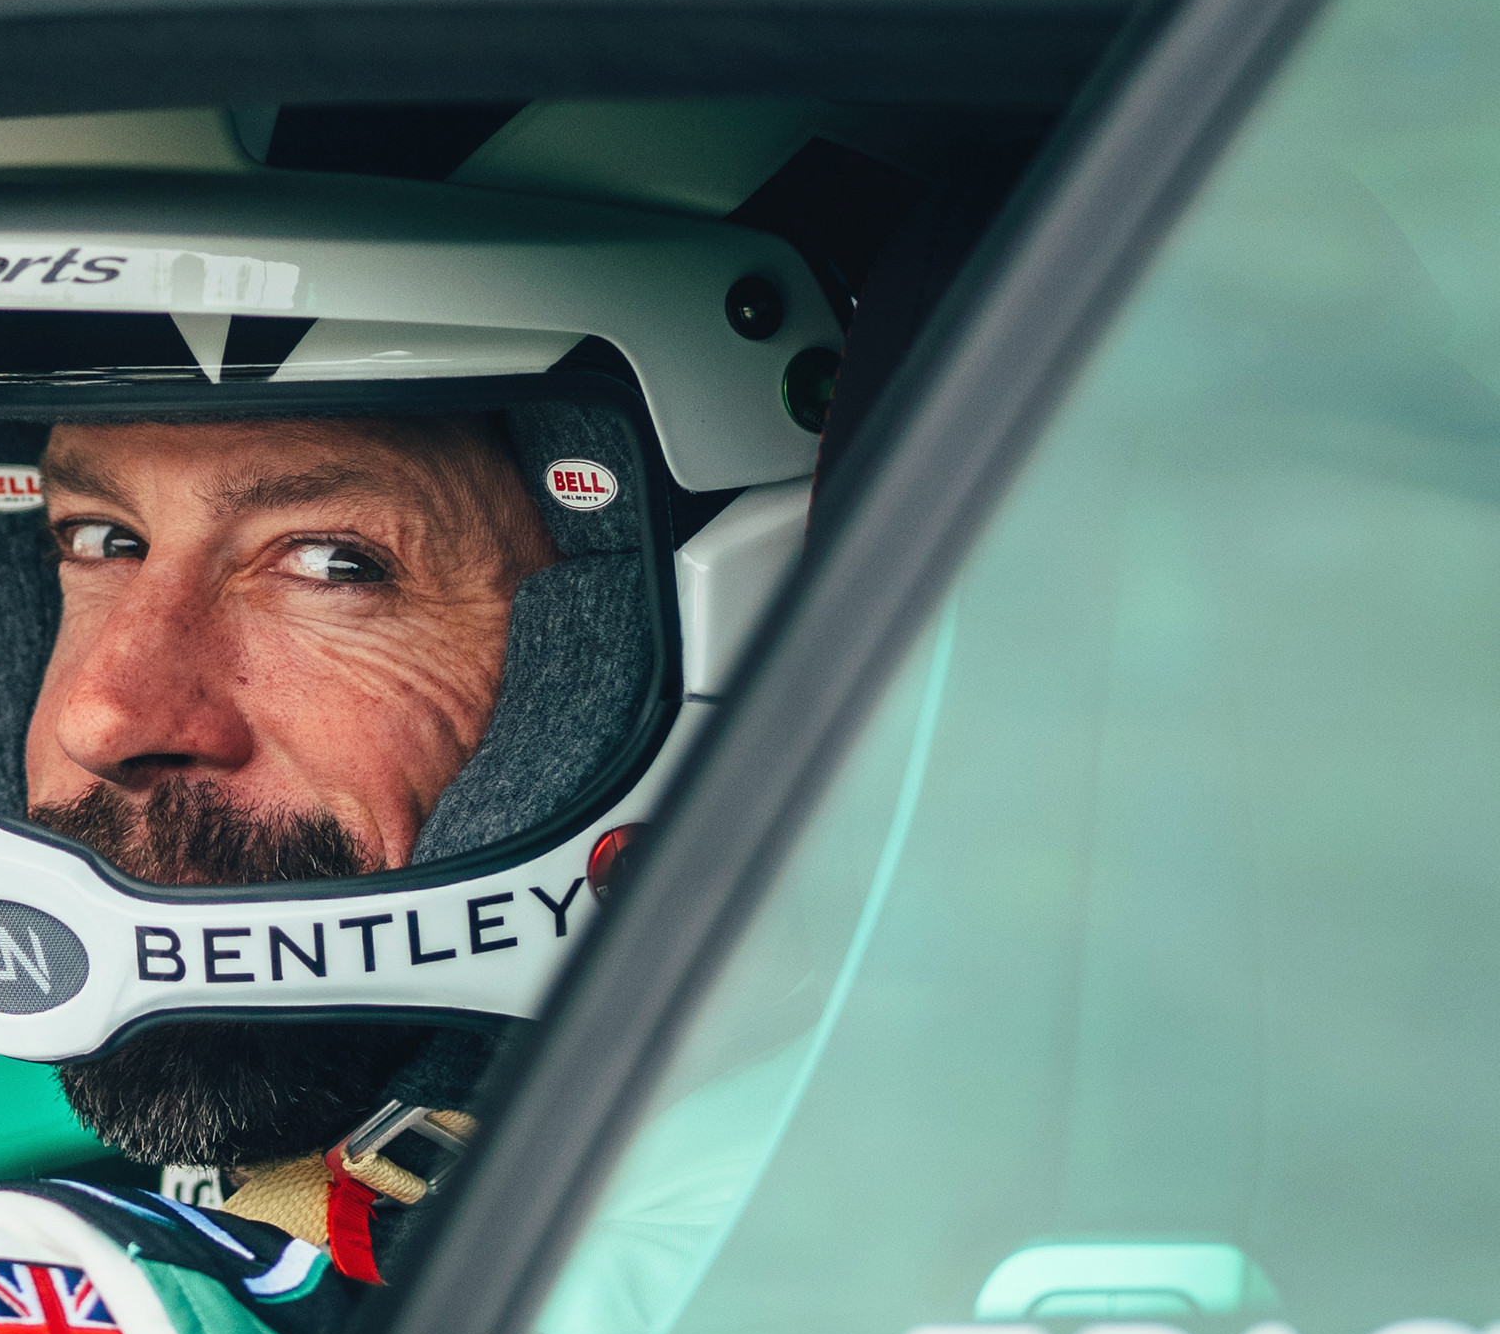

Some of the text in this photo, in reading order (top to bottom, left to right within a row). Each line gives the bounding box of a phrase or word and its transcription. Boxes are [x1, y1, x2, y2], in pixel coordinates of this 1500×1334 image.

[552, 470, 606, 494] BELL
[561, 494, 599, 502] HELMETS
[134, 876, 590, 984] BENTLEY
